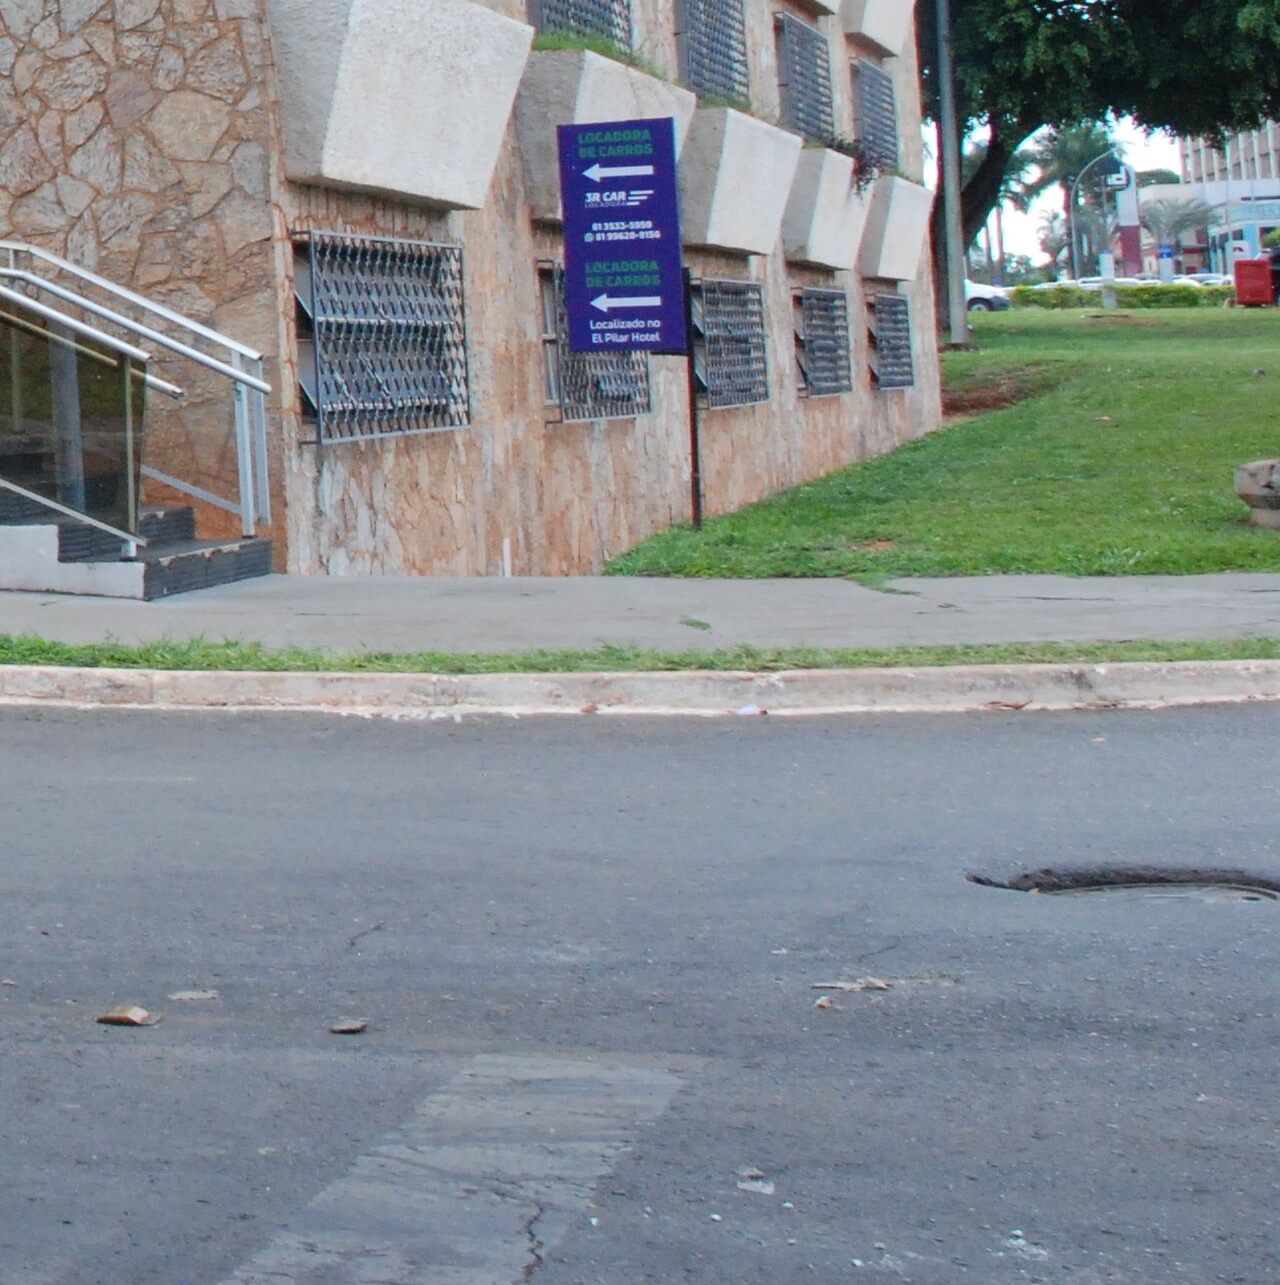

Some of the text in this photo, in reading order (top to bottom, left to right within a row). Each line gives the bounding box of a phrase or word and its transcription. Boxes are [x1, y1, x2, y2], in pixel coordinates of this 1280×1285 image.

[578, 129, 651, 143] LOCADORA
[579, 144, 653, 158] DE CARROS
[585, 191, 627, 202] 3R CAR
[584, 200, 627, 208] LOCADORA
[591, 222, 602, 231] 61
[595, 232, 605, 241] 61
[585, 260, 659, 273] LOCADORA
[586, 275, 661, 288] DE CARROS
[589, 318, 661, 329] Localizado no
[591, 331, 661, 343] El Pilar Hotel
